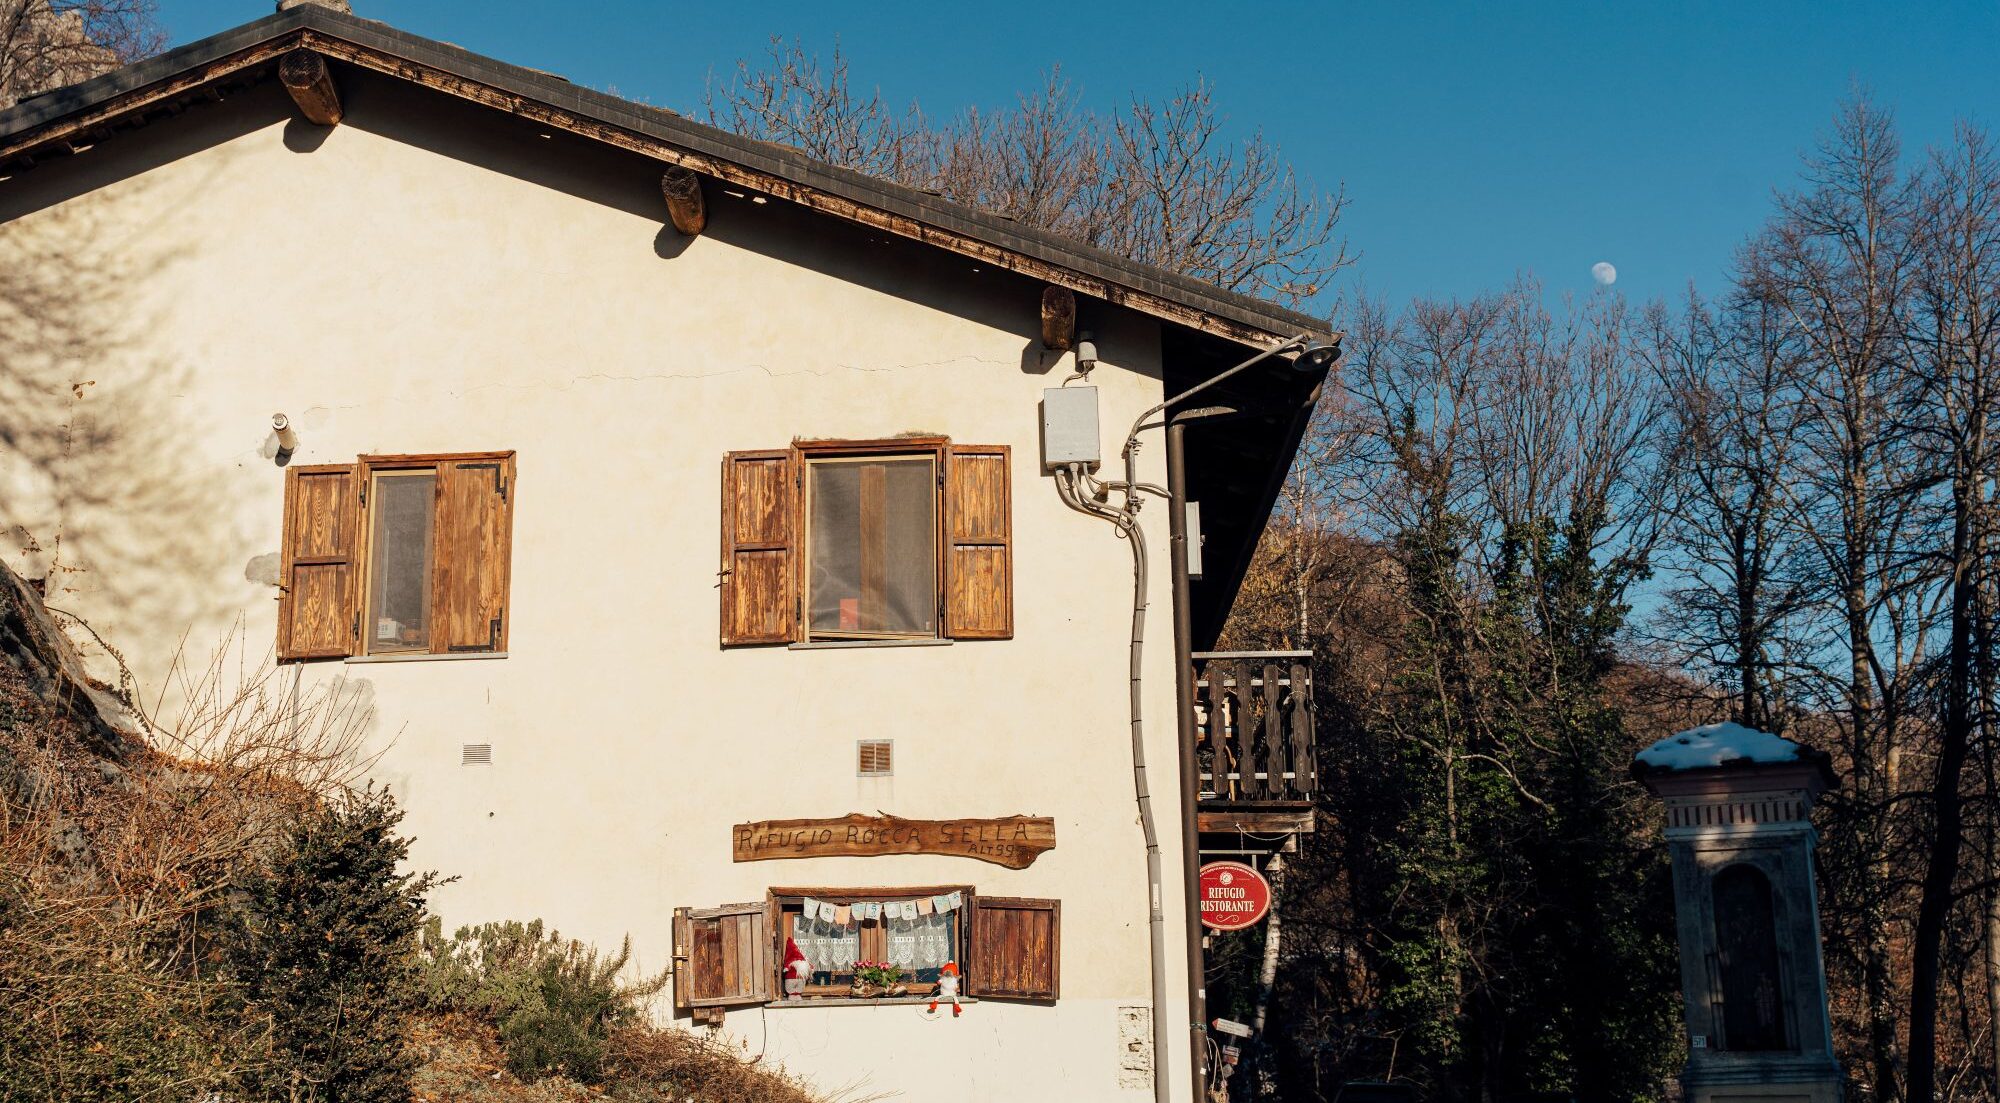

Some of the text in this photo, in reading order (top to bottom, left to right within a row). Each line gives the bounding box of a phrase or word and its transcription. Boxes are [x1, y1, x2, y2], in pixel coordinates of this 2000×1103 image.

[739, 822, 1029, 853] RIFUGIO ROCCA SELLA
[1208, 887, 1245, 899] RIFUGIO
[1200, 900, 1255, 912] RISTORANTE
